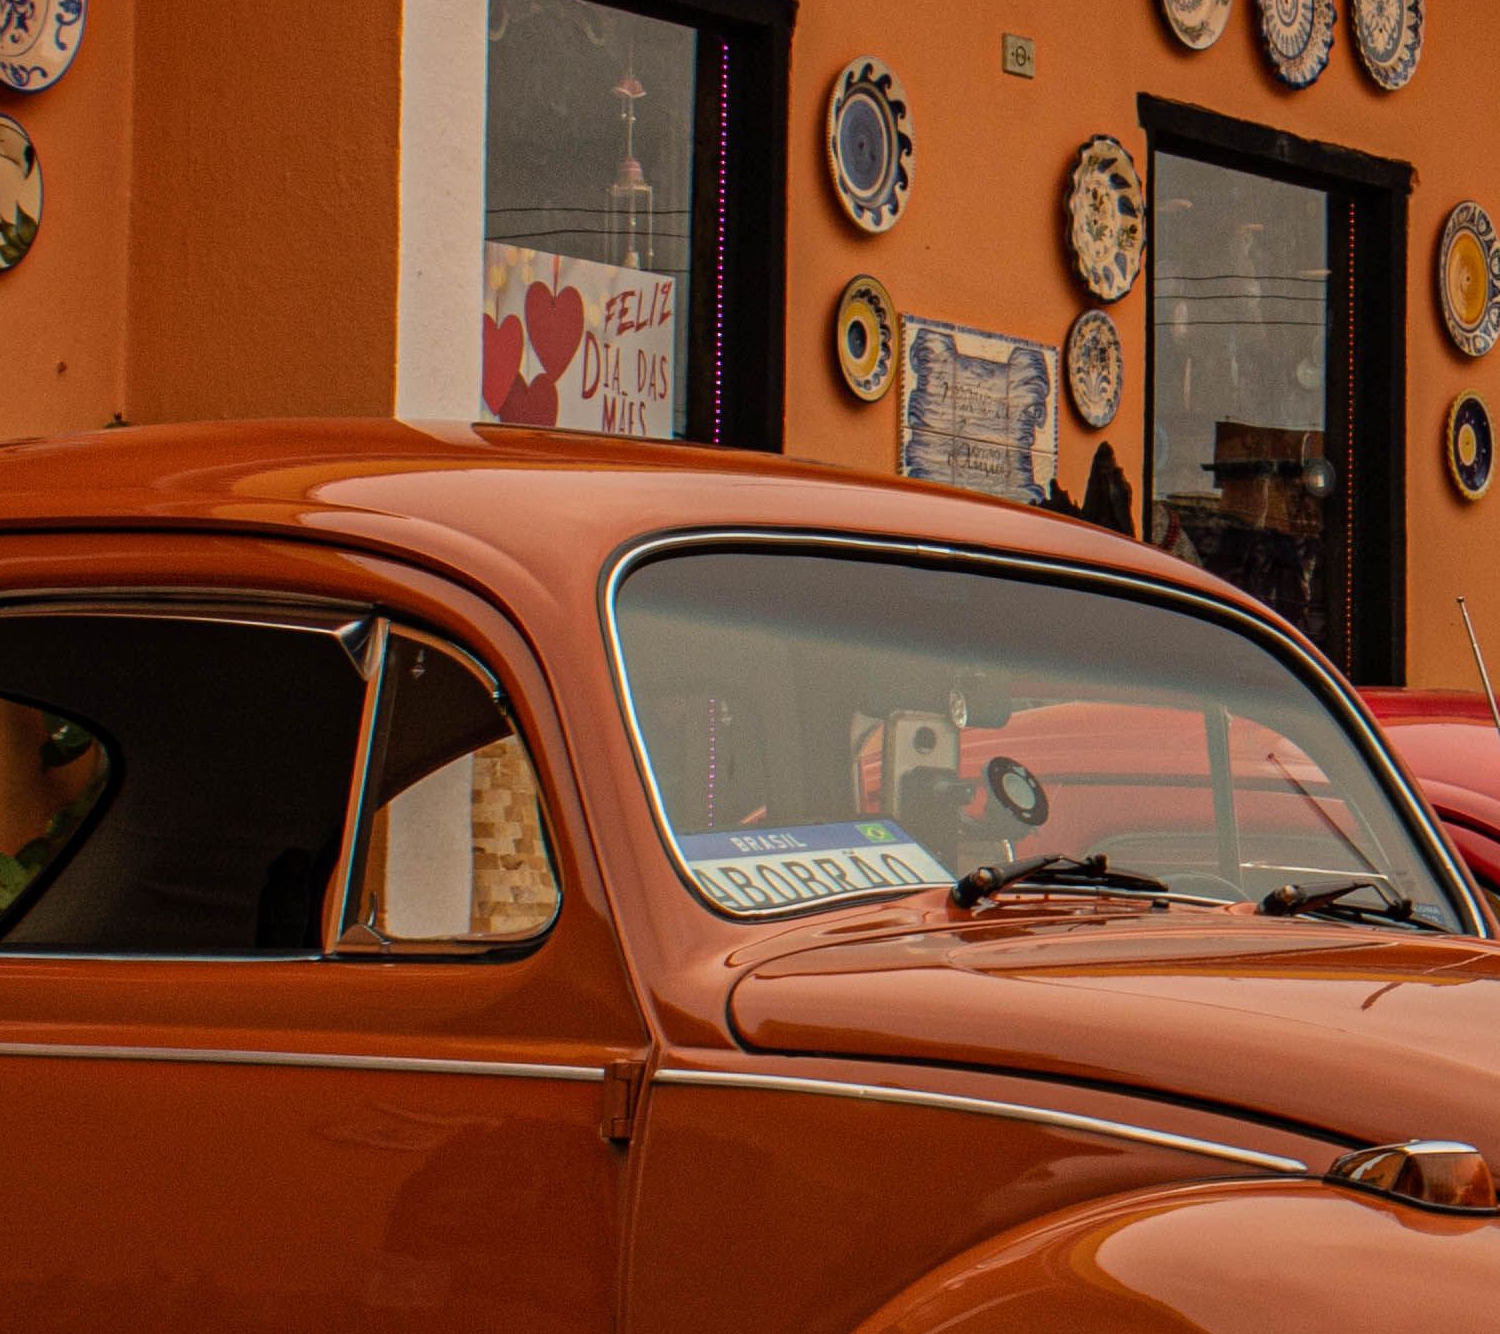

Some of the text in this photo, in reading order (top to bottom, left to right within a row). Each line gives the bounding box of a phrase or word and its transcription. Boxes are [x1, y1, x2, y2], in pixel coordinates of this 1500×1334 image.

[604, 281, 673, 336] FELIZ
[582, 331, 668, 402] DIA DAS
[729, 833, 808, 854] BRASIL
